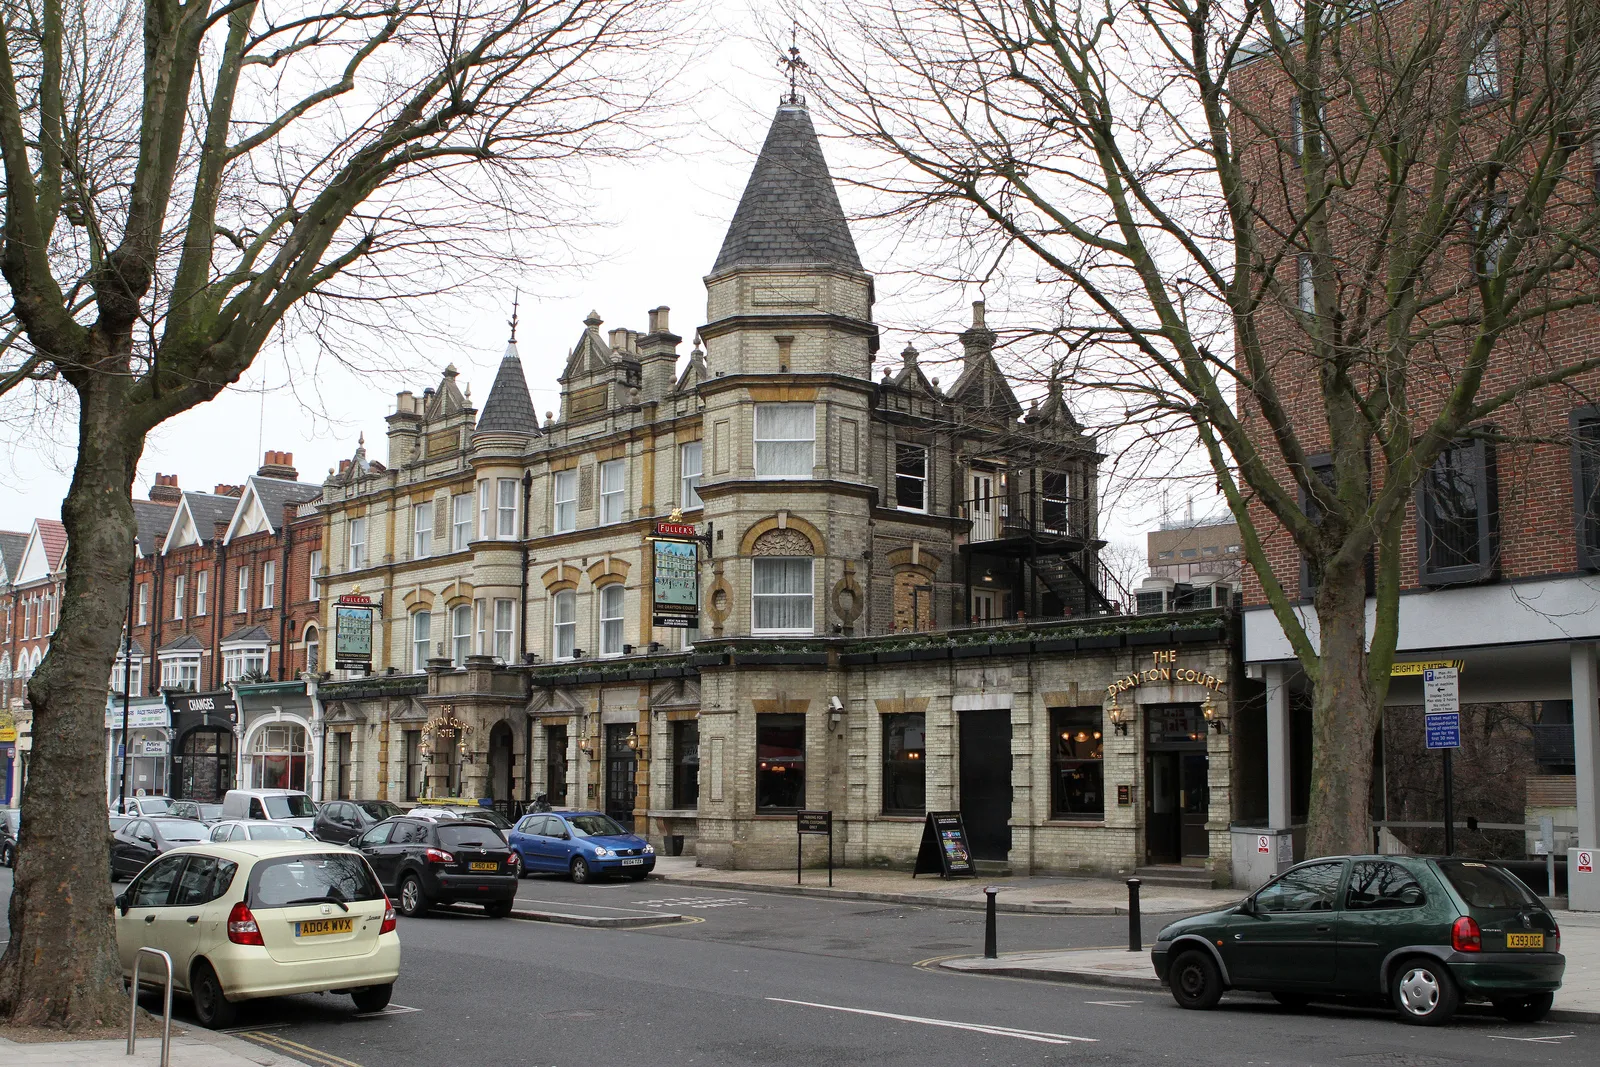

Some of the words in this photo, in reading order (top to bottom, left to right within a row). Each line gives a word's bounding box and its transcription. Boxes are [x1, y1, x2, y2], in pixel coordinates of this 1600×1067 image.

[660, 524, 693, 534] FULLER'S
[1152, 650, 1176, 663] THE
[1108, 668, 1170, 696] DRAYTON
[1176, 668, 1223, 692] COURT
[189, 698, 215, 711] CHANGES
[303, 922, 329, 934] AD04
[332, 919, 350, 931] WVX
[1510, 936, 1528, 946] X393
